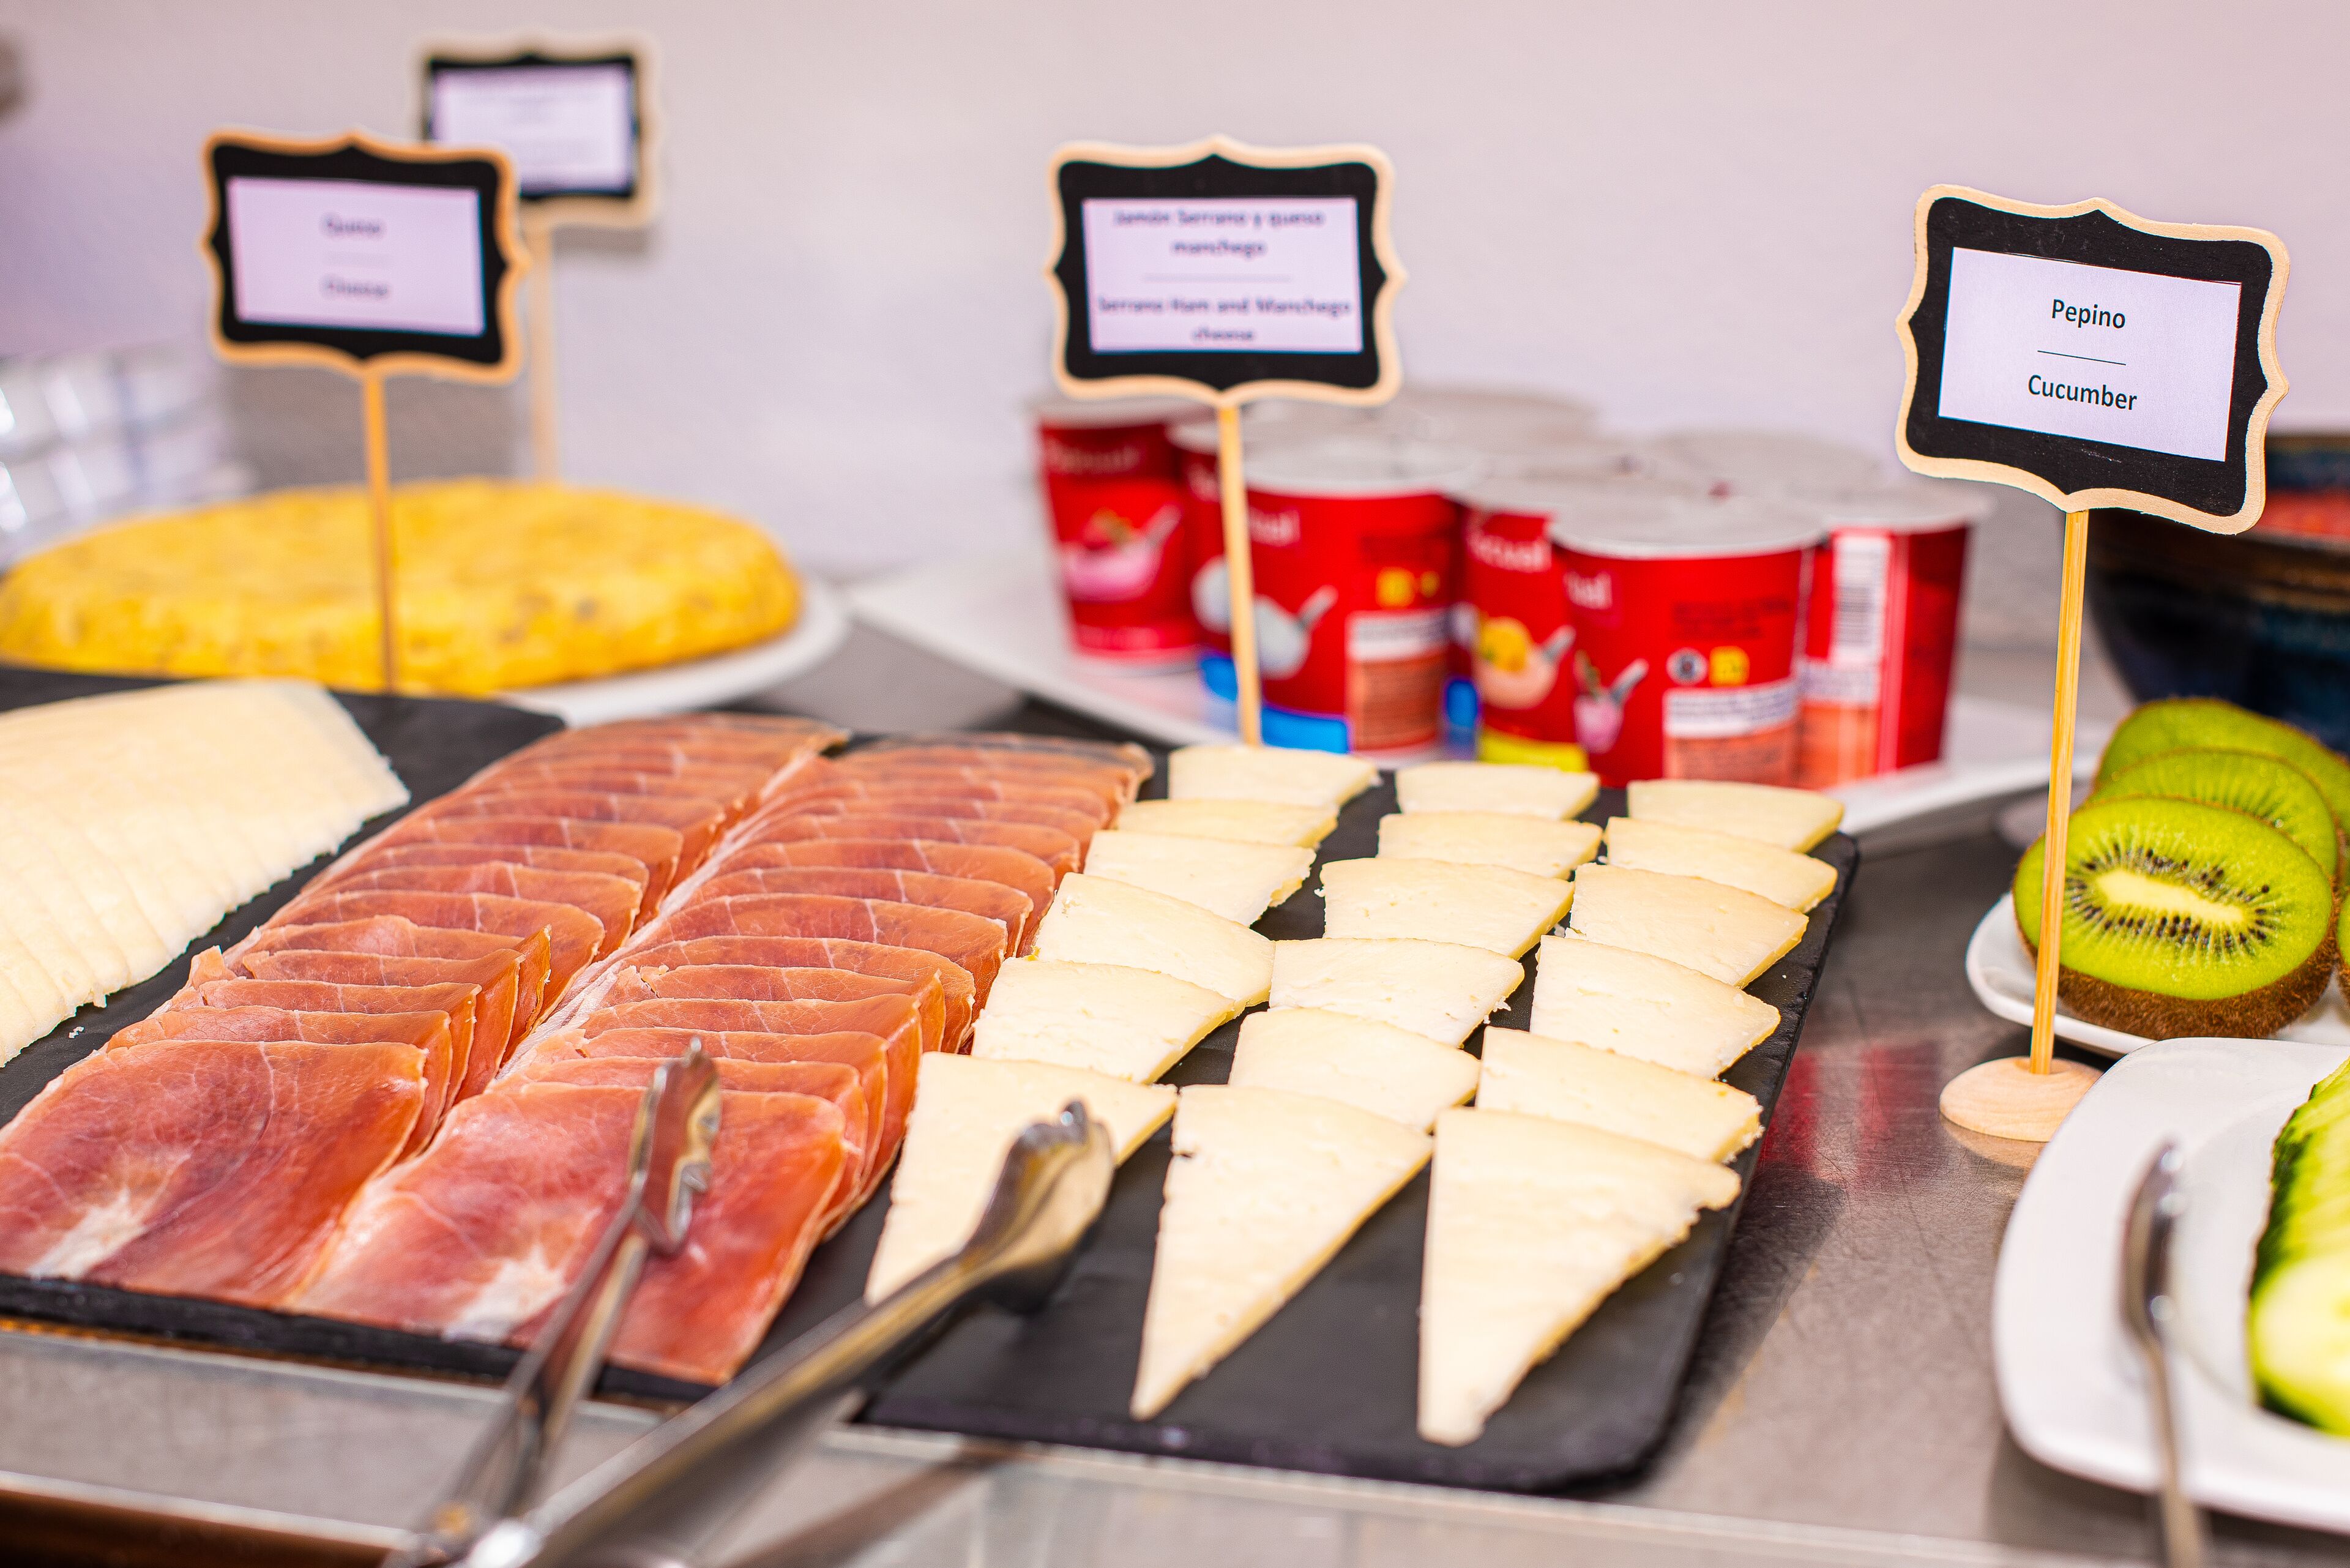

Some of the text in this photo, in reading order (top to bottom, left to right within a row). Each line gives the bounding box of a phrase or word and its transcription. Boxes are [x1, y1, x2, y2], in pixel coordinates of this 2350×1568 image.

[1179, 210, 1246, 226] Serrano
[1099, 296, 1162, 313] Serrano
[1218, 297, 1249, 313] and
[1256, 298, 1350, 318] Manchego
[2052, 299, 2125, 329] Pepino
[2028, 374, 2137, 410] Cucumber
